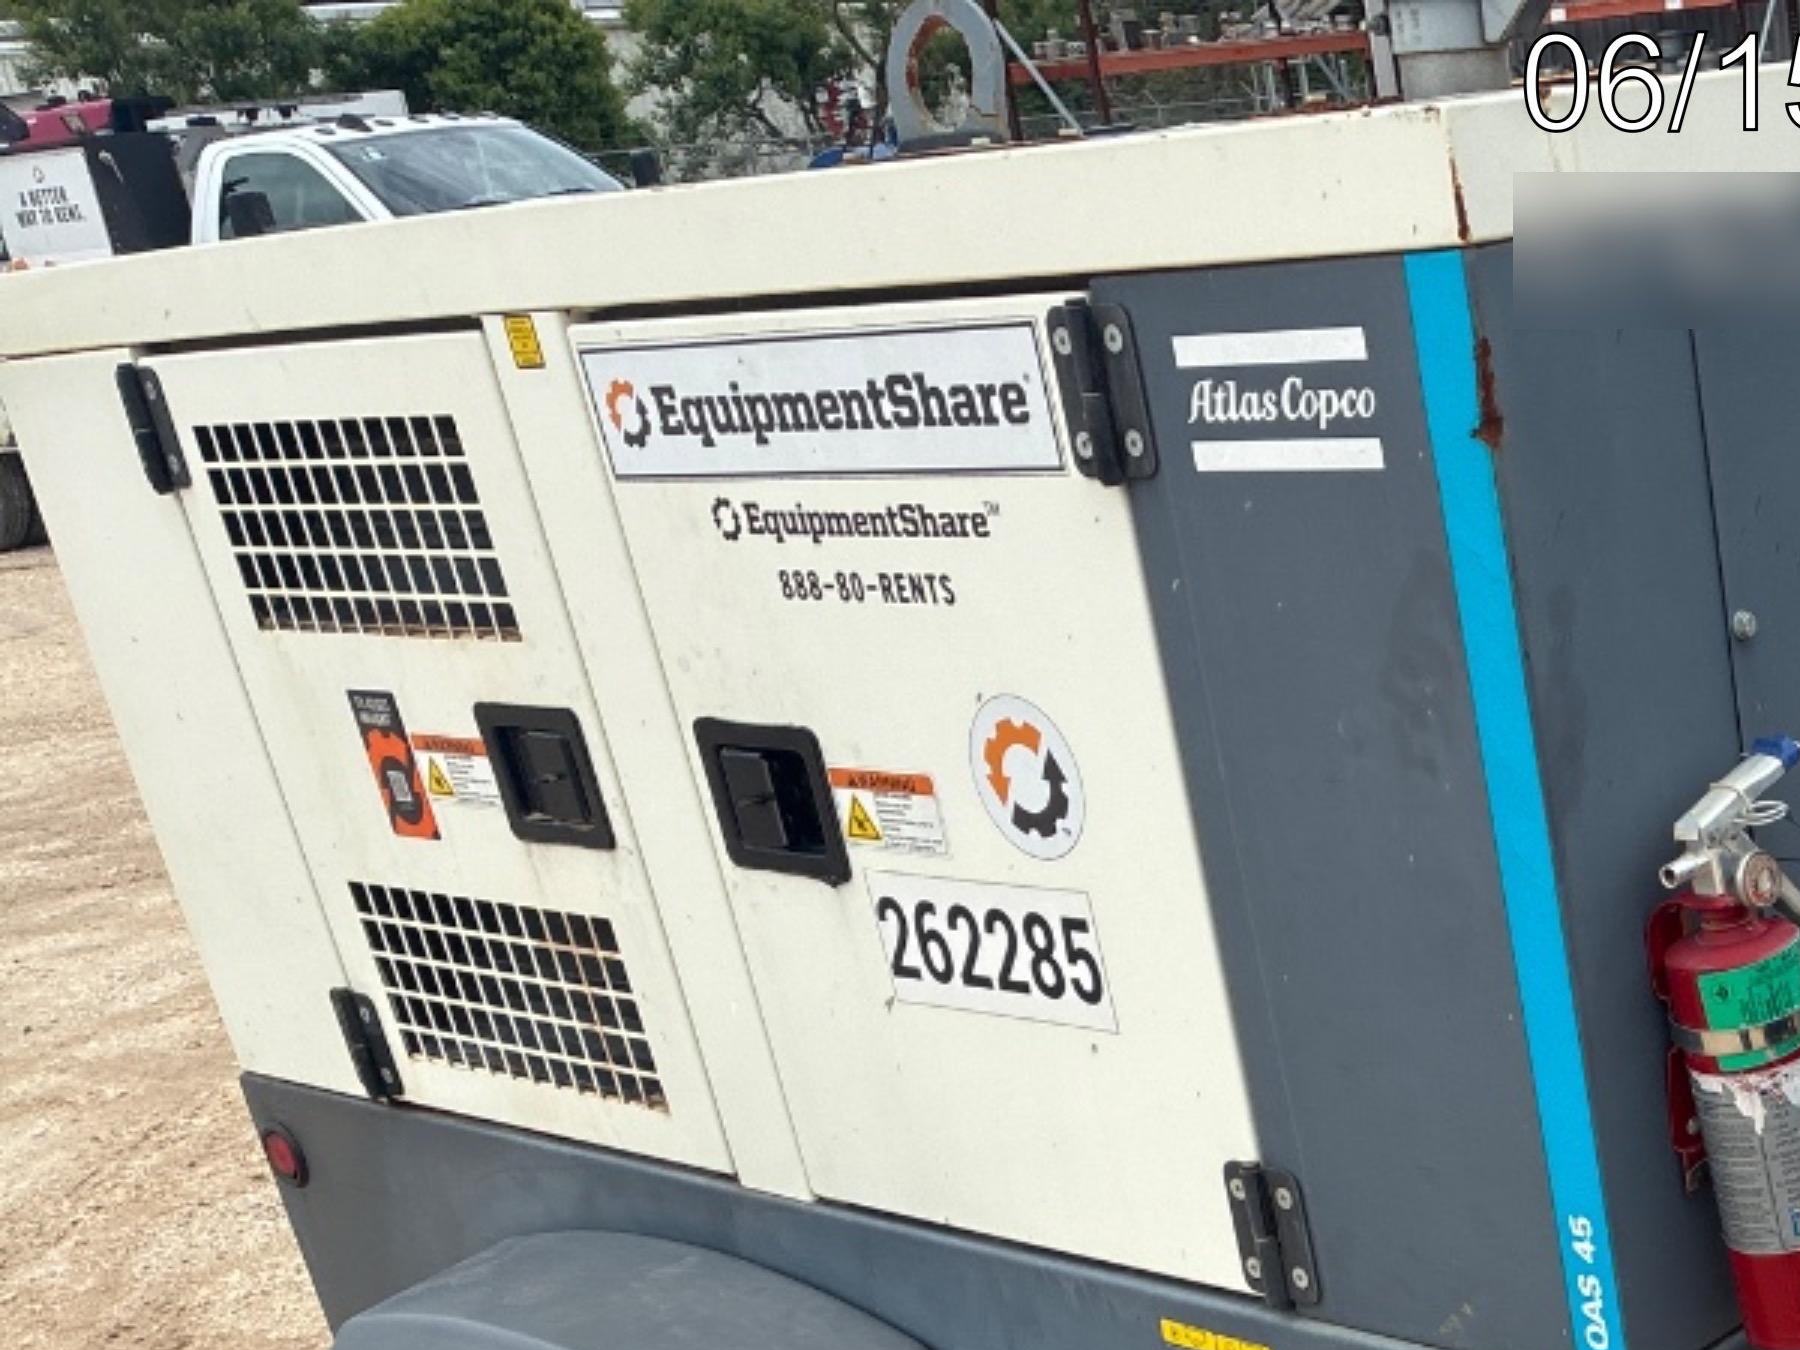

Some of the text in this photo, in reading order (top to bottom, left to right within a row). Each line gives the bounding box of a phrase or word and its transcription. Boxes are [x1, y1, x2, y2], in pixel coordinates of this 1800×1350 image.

[649, 372, 1032, 448] EquipmentShare
[1187, 375, 1376, 431] Atlas Copco
[778, 569, 956, 606] 888-80-RENTS
[876, 895, 1103, 1006] 262285
[1568, 1214, 1595, 1265] 45
